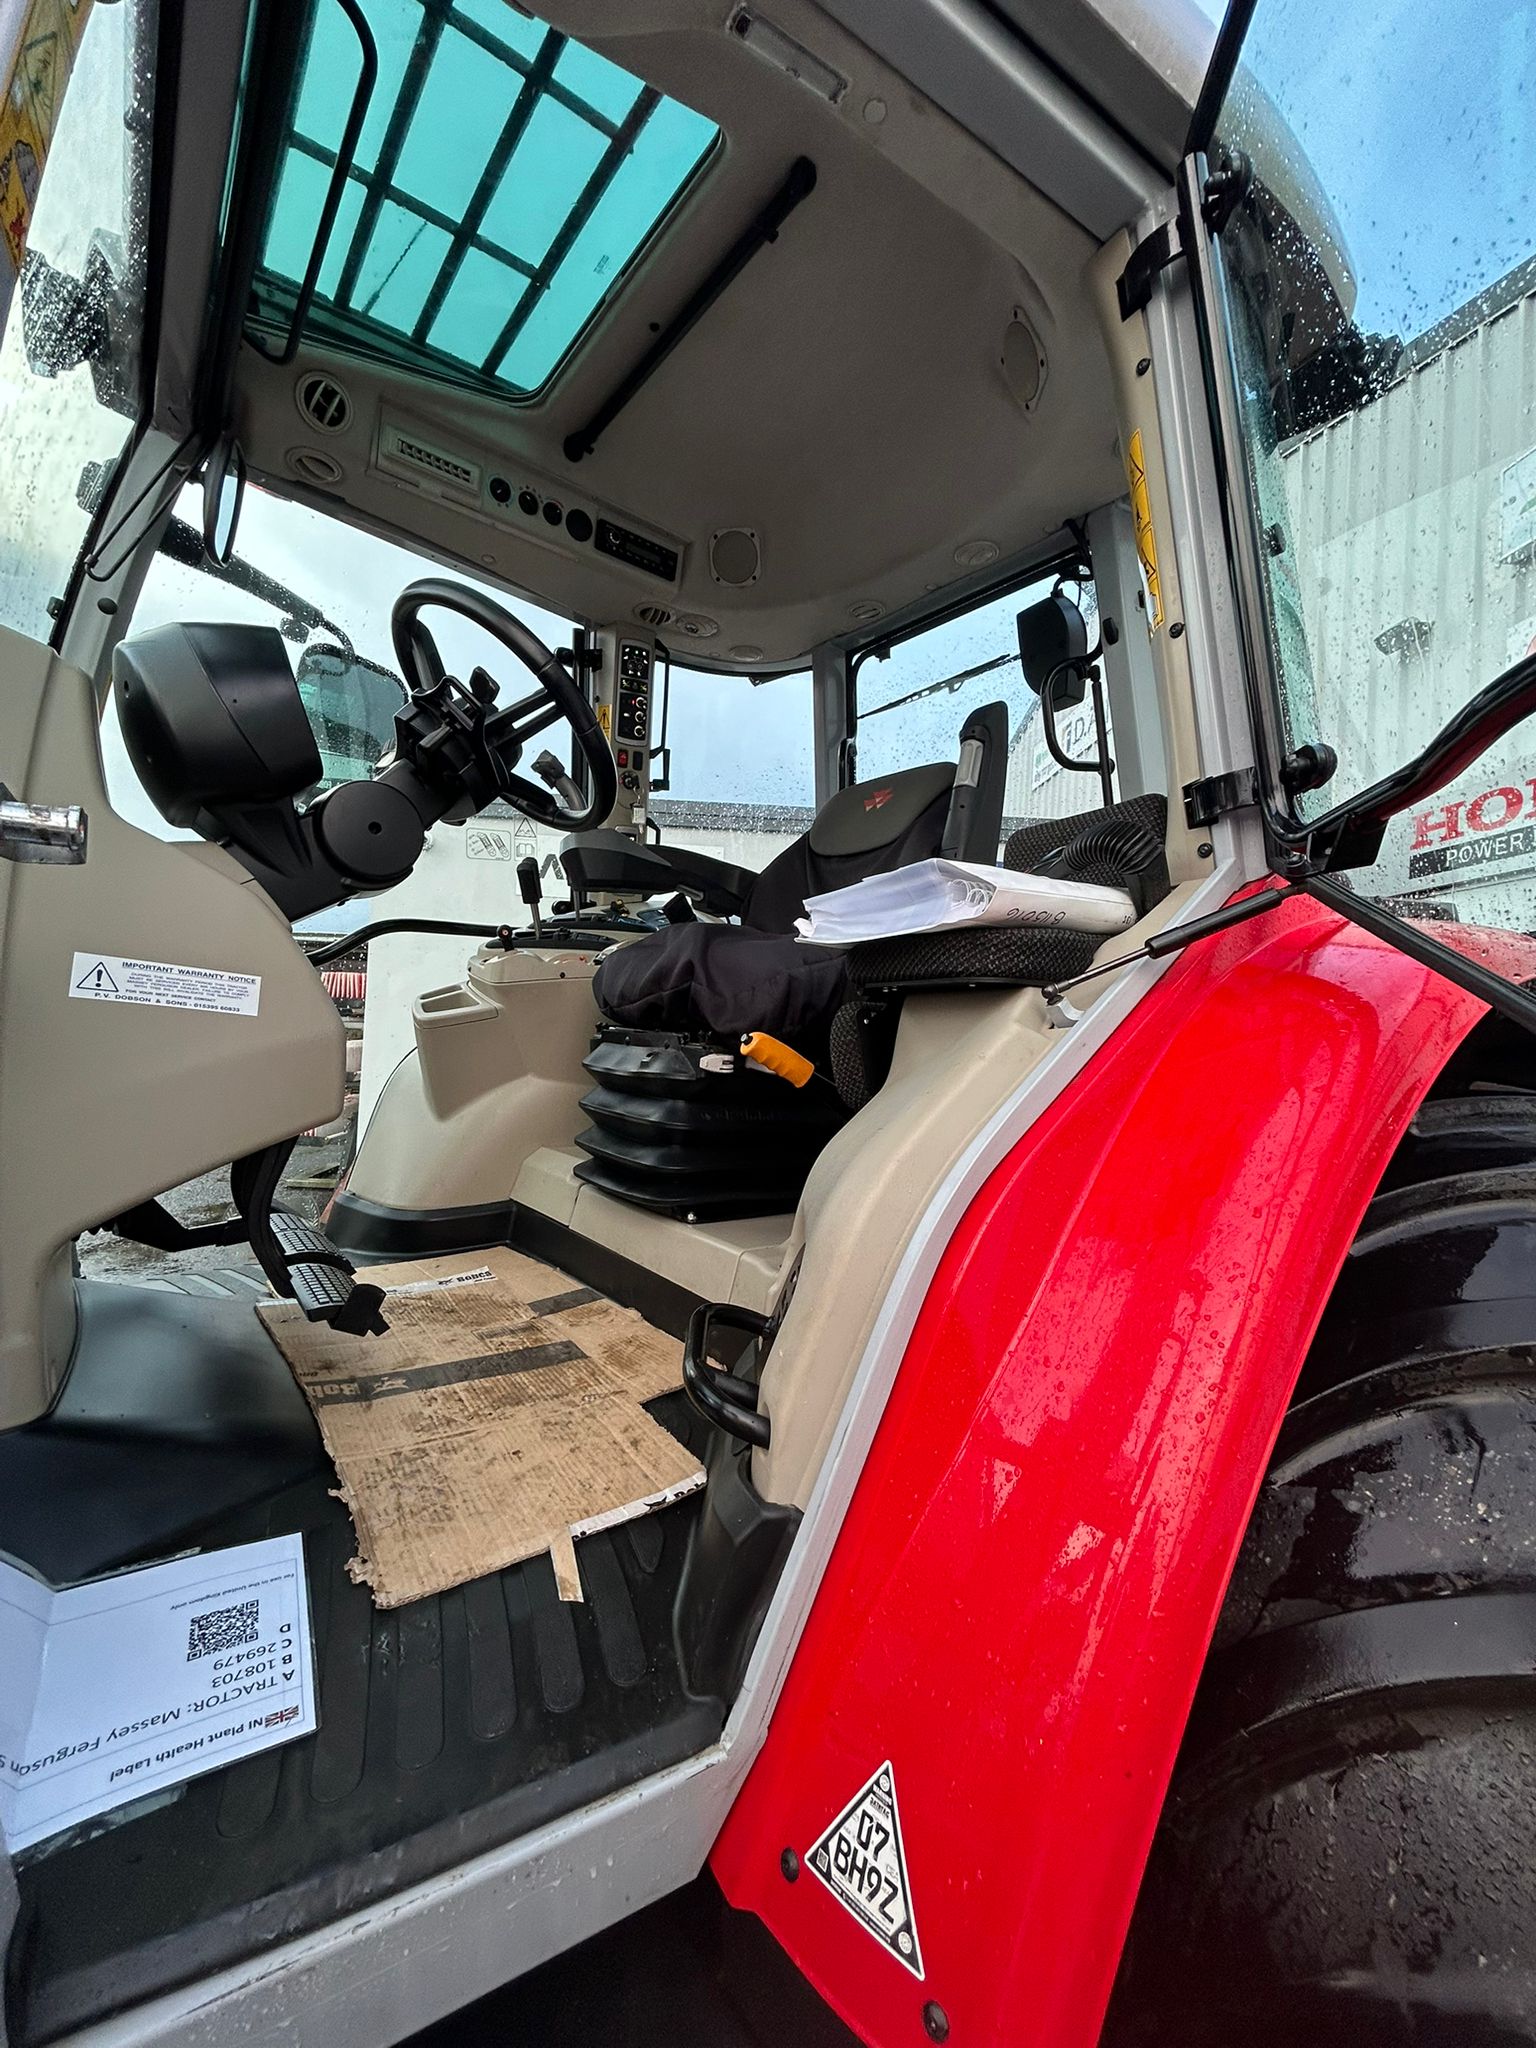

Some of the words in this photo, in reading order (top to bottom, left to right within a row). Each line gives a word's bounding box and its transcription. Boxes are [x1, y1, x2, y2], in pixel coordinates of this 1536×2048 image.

[1445, 832, 1524, 867] POWER
[122, 961, 173, 973] IMPORTANT
[178, 968, 224, 980] WARRANTY
[228, 975, 256, 984] NOTICE
[114, 993, 151, 1003] DOBSON
[280, 1623, 291, 1634] D
[212, 1642, 276, 1671] 269479
[281, 1638, 292, 1649] C
[281, 1654, 292, 1665] B
[211, 1658, 276, 1688] 108703
[282, 1670, 295, 1682] A
[187, 1675, 278, 1713] TRACTOR:
[107, 1707, 181, 1742] Massey
[208, 1723, 244, 1743] Plant
[248, 1717, 263, 1731] NI
[10, 1737, 101, 1778] Ferguson
[156, 1737, 204, 1763] Health
[109, 1756, 151, 1782] Label
[833, 1832, 899, 1924] BH9Z
